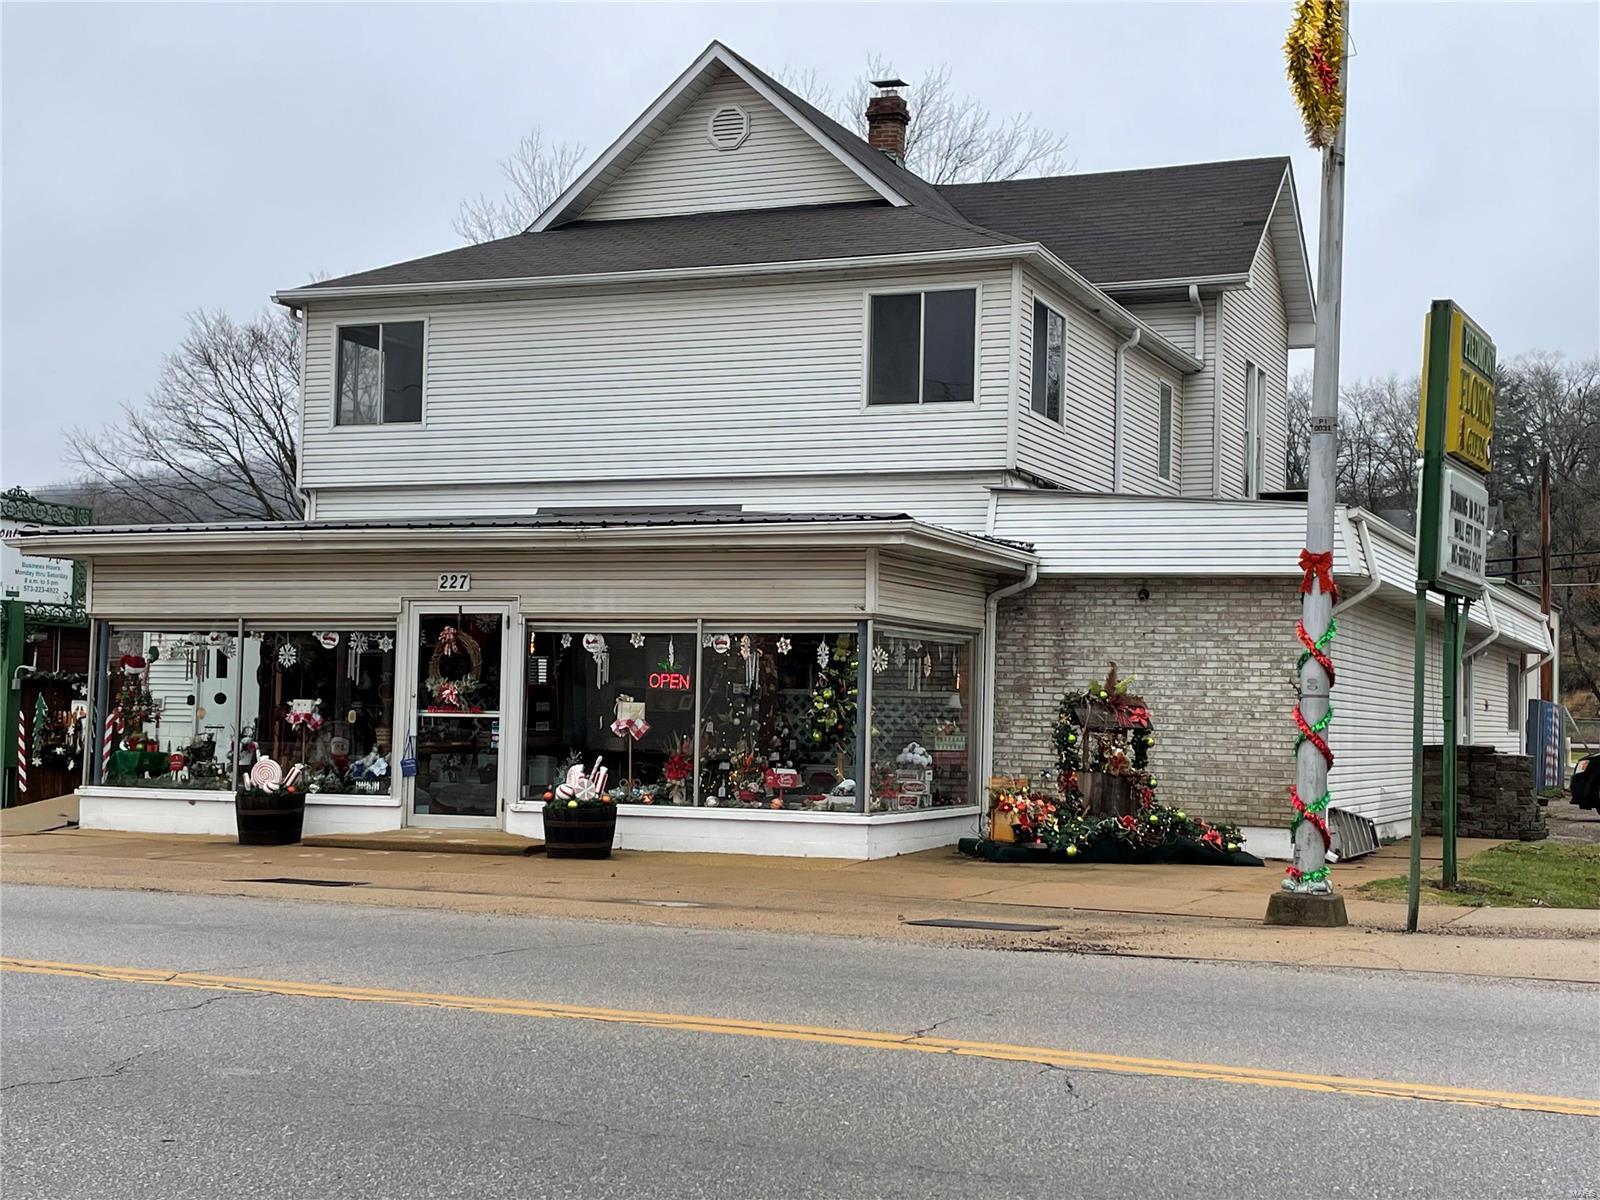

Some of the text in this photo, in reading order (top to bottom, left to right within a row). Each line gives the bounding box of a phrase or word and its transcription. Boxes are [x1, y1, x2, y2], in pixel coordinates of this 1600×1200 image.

[1459, 367, 1494, 431] FLORIST
[440, 574, 468, 589] 227
[649, 672, 690, 690] OPEN
